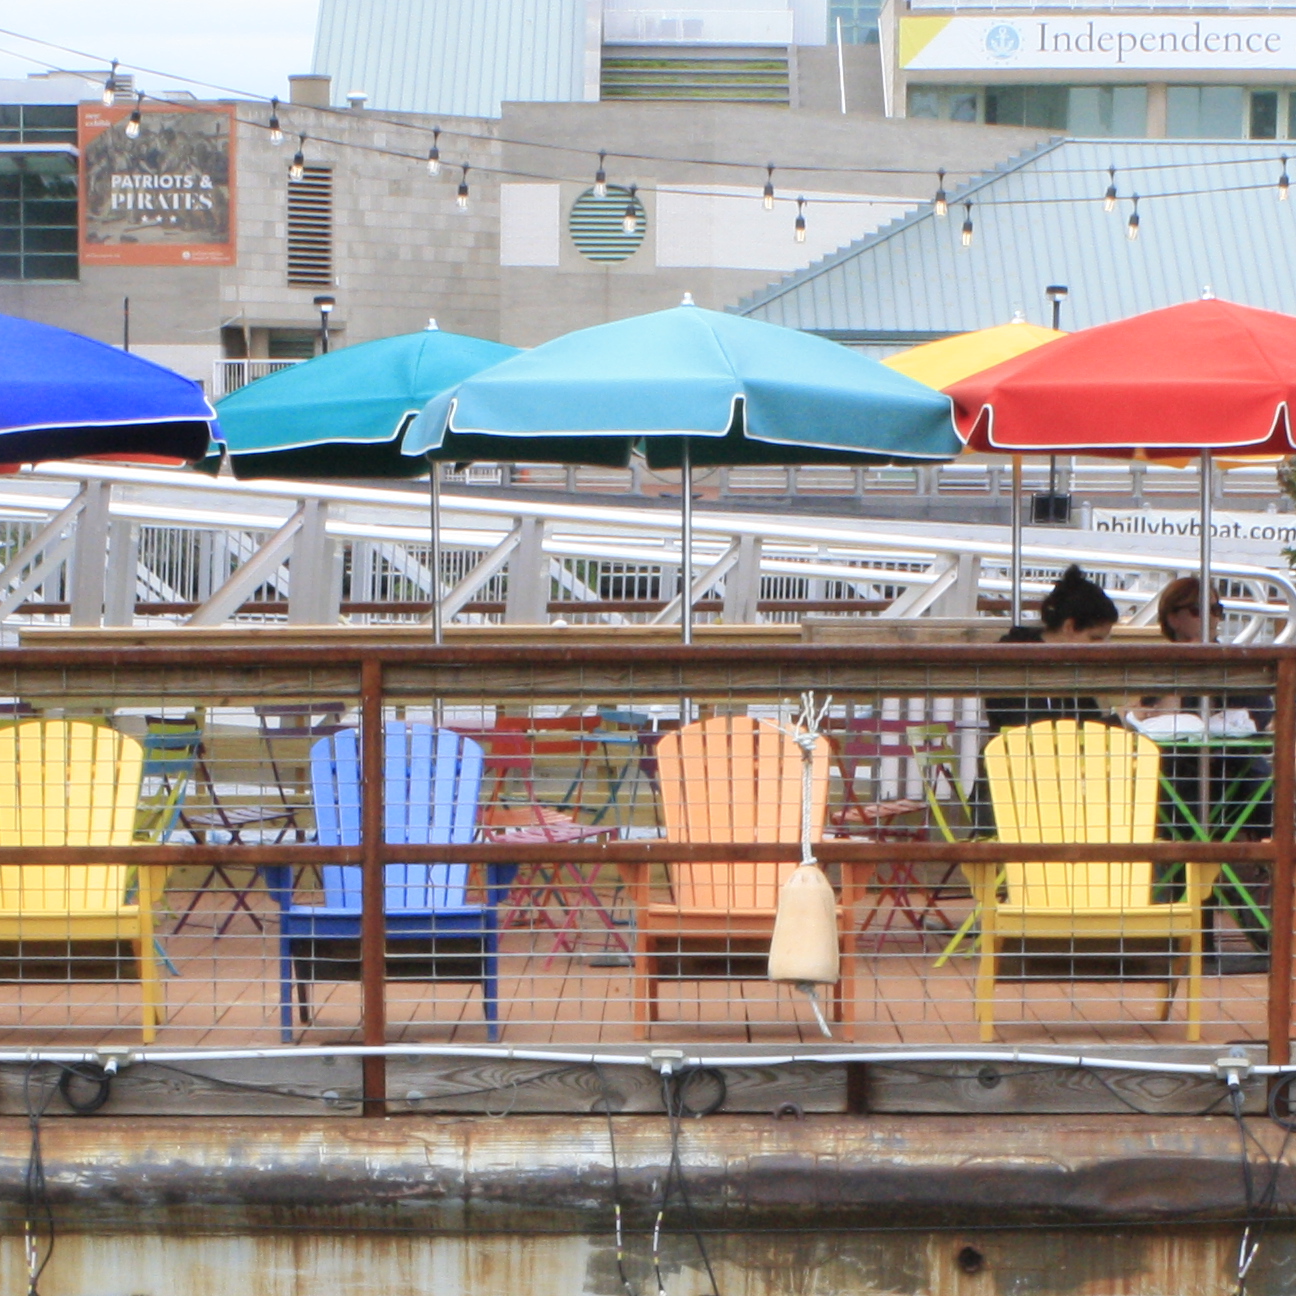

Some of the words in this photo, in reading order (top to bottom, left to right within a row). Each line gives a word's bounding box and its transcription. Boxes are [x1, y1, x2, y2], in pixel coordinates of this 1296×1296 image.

[1036, 21, 1281, 64] Independence
[111, 174, 193, 189] PATRIOTS
[199, 174, 213, 189] &
[111, 192, 213, 210] PIRATES
